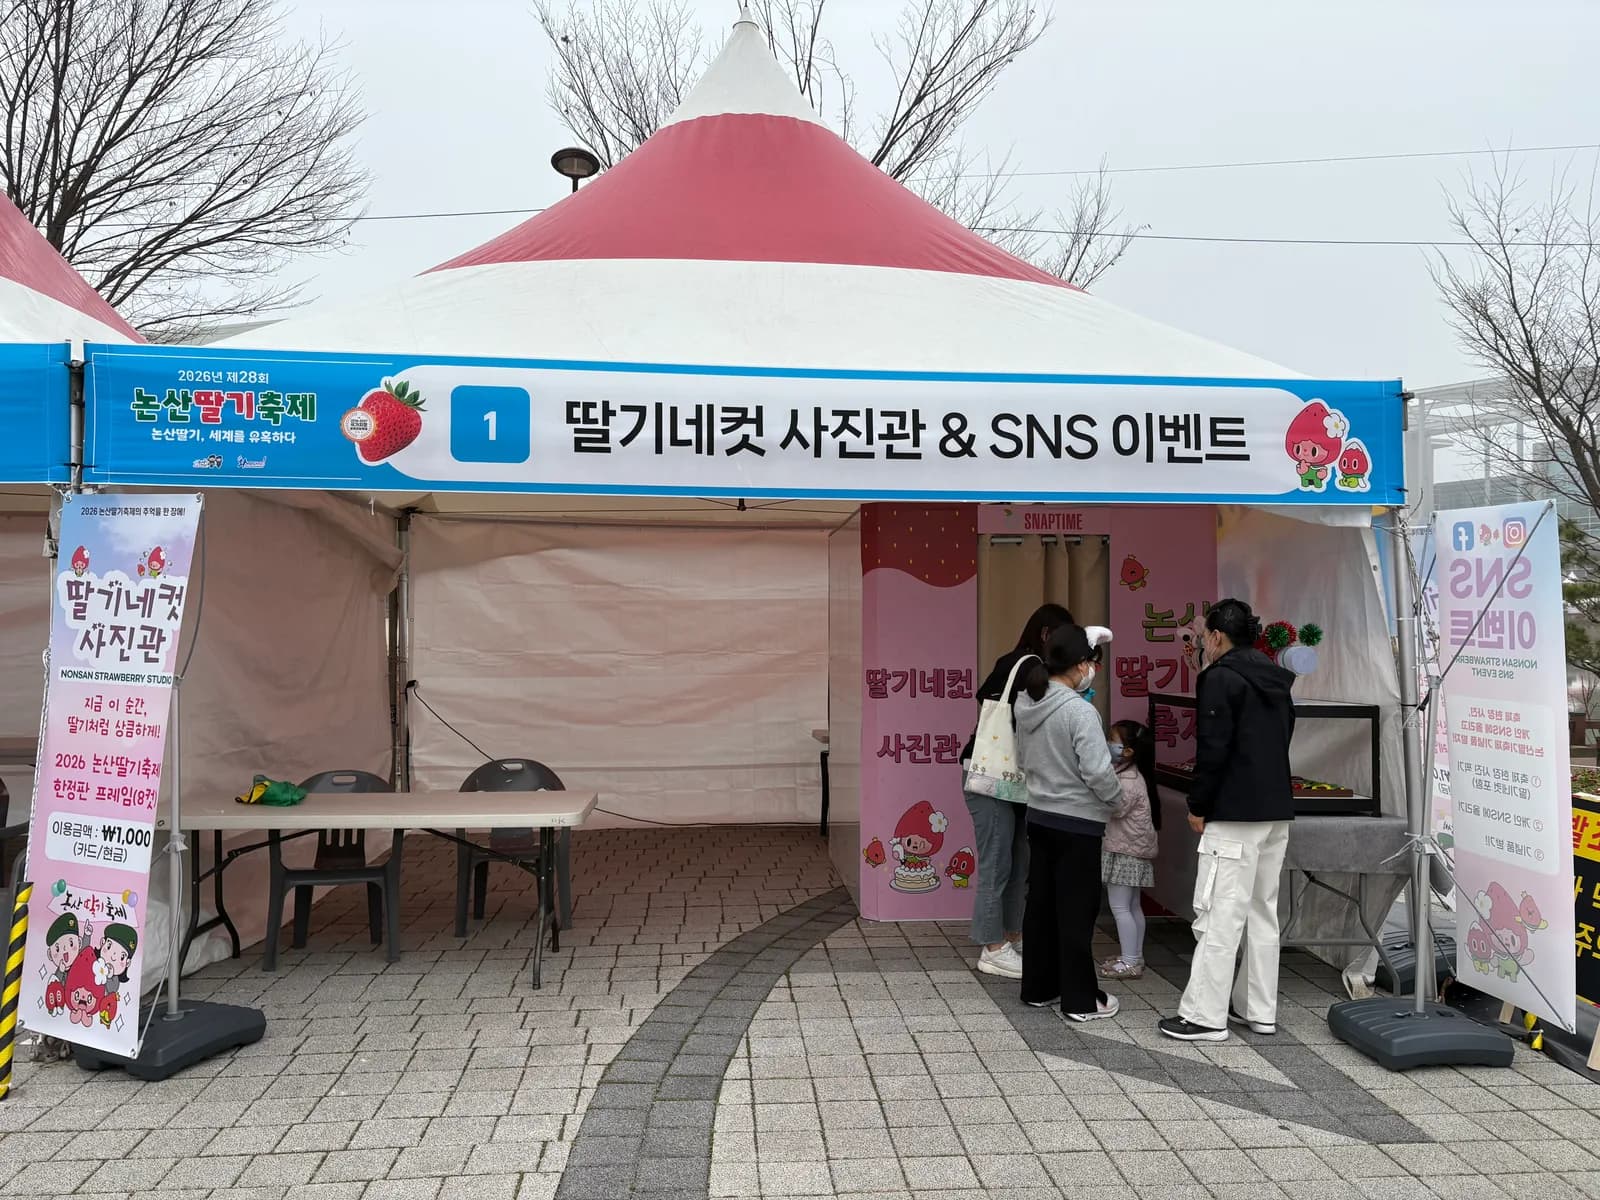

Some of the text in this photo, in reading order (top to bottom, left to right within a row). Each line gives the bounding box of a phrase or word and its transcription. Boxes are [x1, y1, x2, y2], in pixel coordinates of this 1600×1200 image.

[178, 370, 269, 384] 2026년 제28회
[131, 387, 317, 426] 논산딸기축제
[151, 428, 296, 444] 논산딸기, 세계를 유혹하다
[482, 410, 498, 441] 1
[565, 399, 1250, 464] 딸기네컷 사진관 & SNS 이벤트
[81, 507, 98, 516] 2026
[1024, 513, 1083, 530] SNAPTIME
[66, 580, 184, 621] 딸기네컷
[79, 623, 166, 663] 사진관
[61, 669, 172, 685] NONSAN STRAWBERRY STUDIO
[865, 668, 974, 699] 딸기네컷
[1115, 655, 1190, 698] 딸기
[84, 695, 147, 717] 지금 이 순간,
[67, 716, 160, 739] 딸기처럼 상큼하게!
[877, 733, 961, 764] 사진관
[55, 753, 161, 779] 2026 논산딸기축제
[53, 778, 157, 809] 한정판 프레임(8컷)
[52, 821, 93, 838] 이용금액
[101, 824, 151, 847] ₩1,000
[73, 844, 128, 863] (카드/현금)
